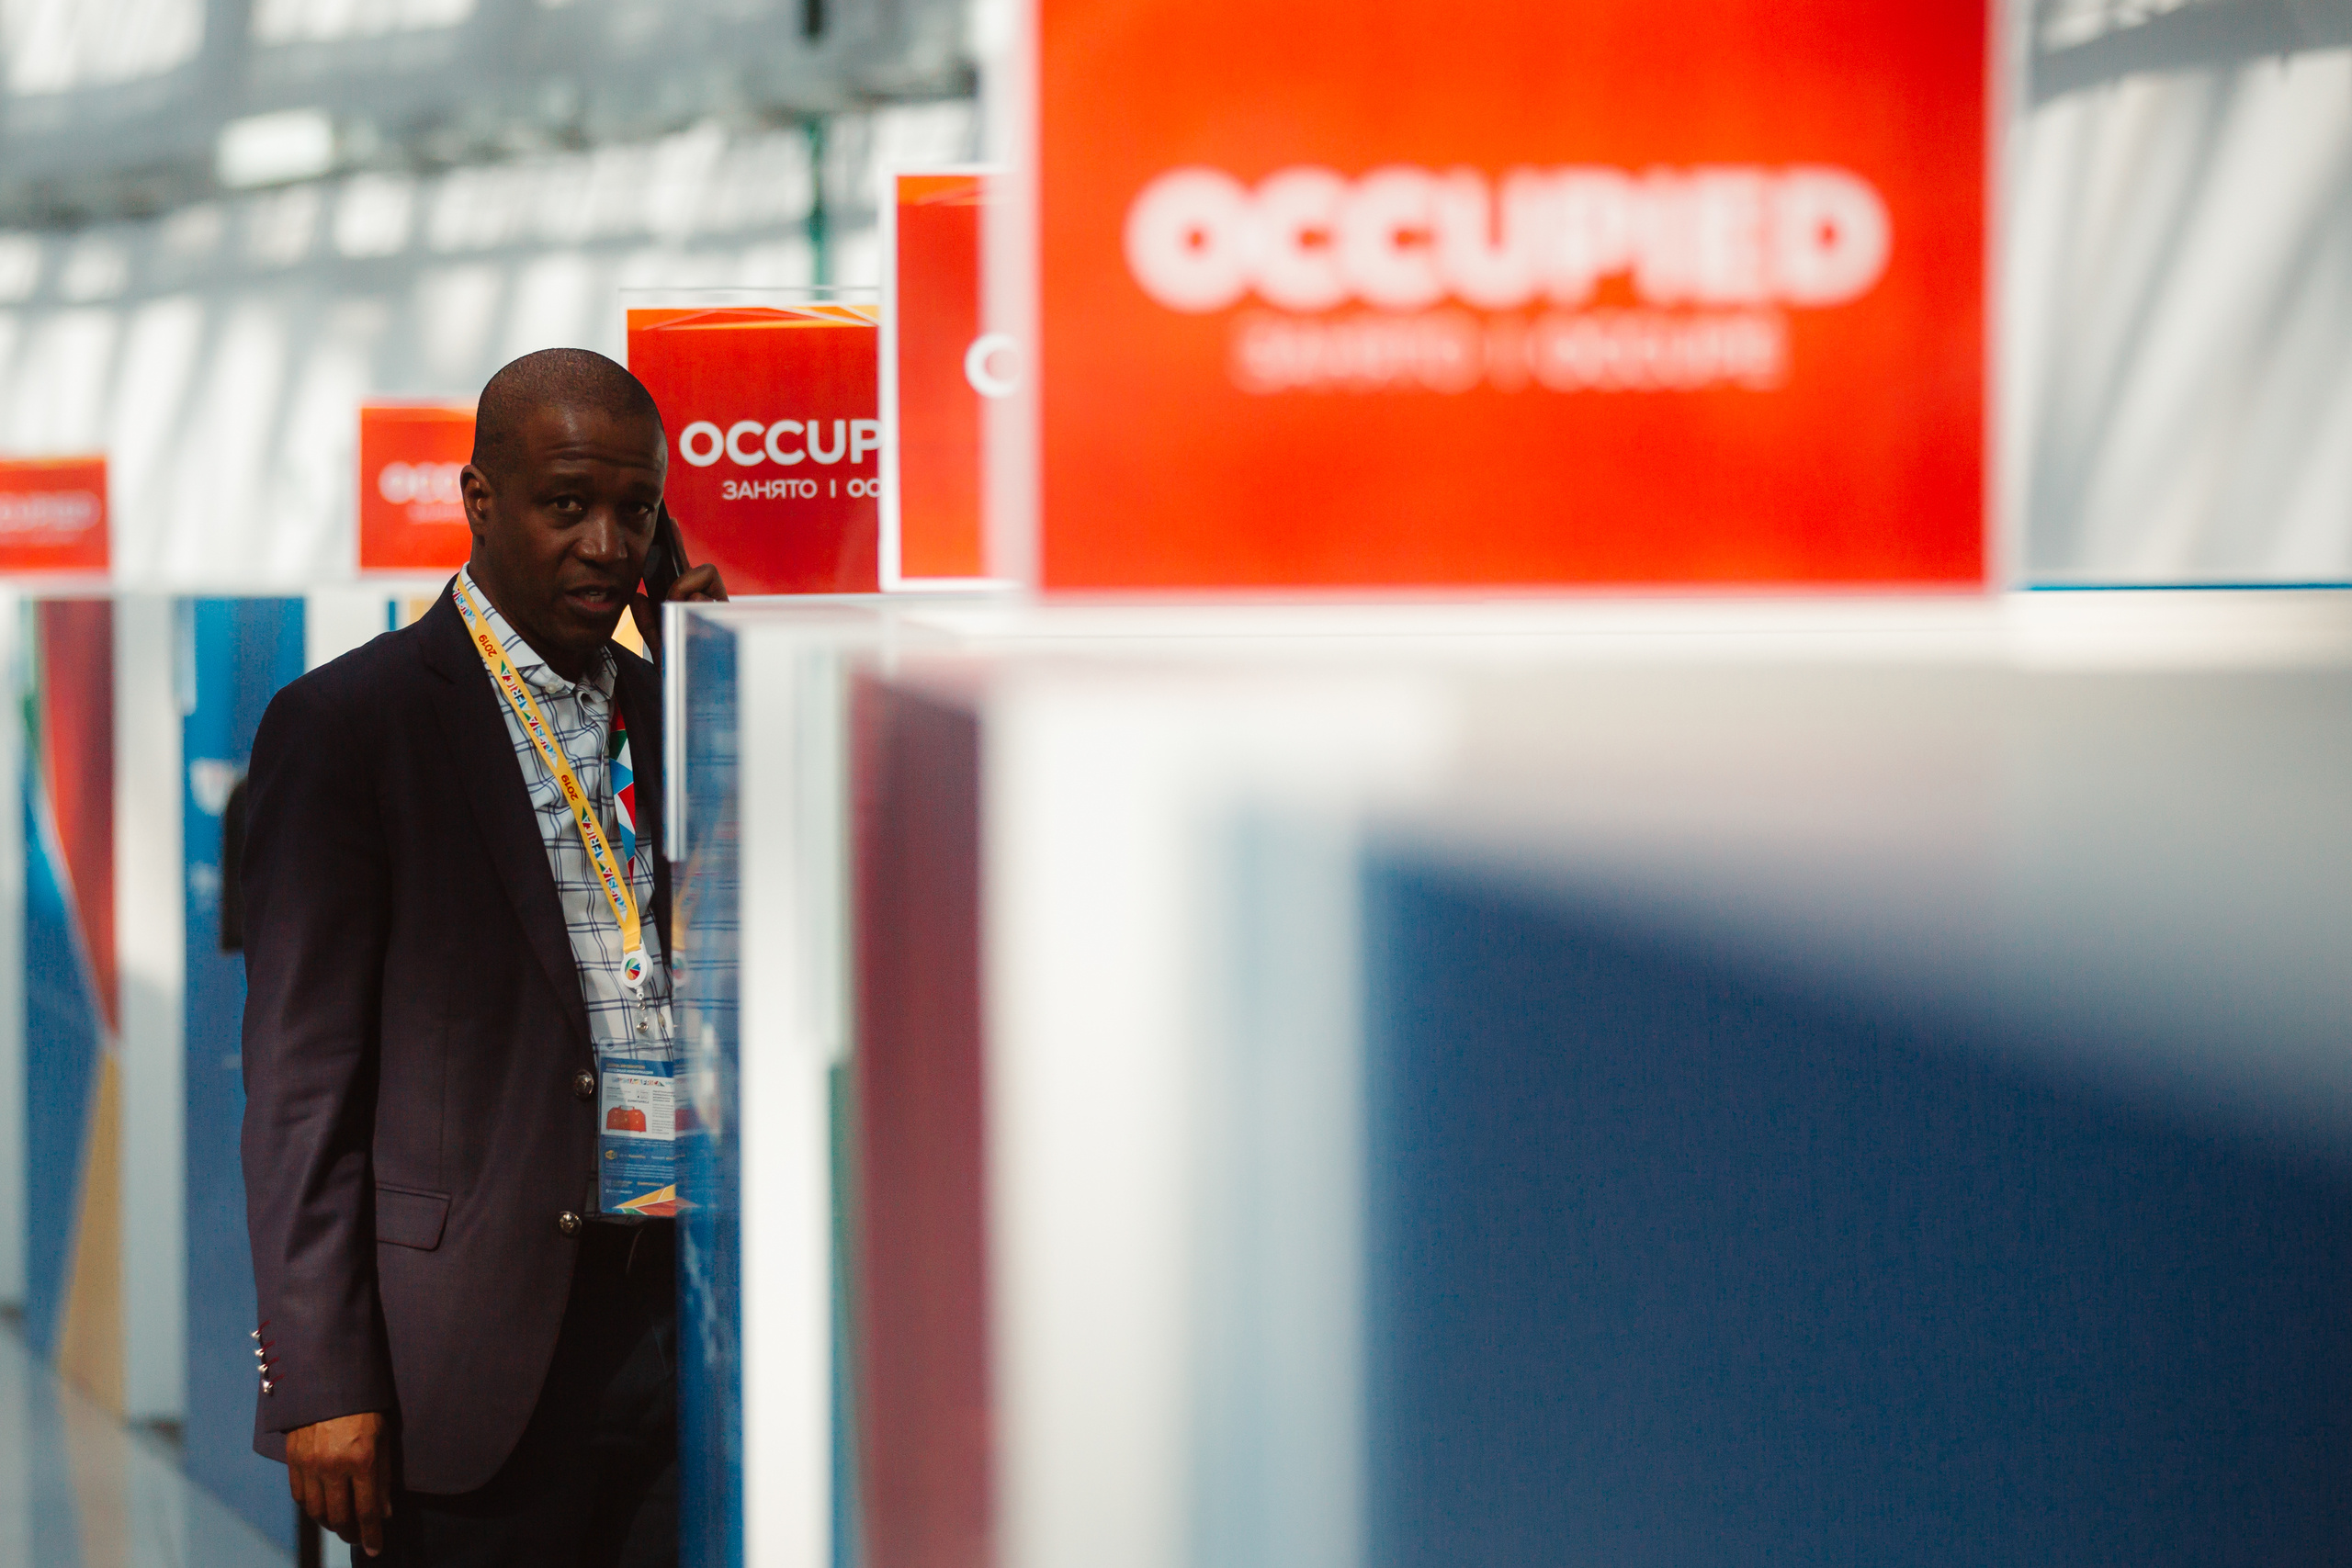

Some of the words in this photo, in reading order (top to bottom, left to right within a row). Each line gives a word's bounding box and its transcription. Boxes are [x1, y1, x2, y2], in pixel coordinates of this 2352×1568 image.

[1125, 167, 1891, 312] OCCUPIED
[679, 419, 882, 467] OCCUP
[722, 479, 818, 500] ЗАНЯТО
[478, 634, 498, 658] 2019
[561, 773, 579, 801] 2019
